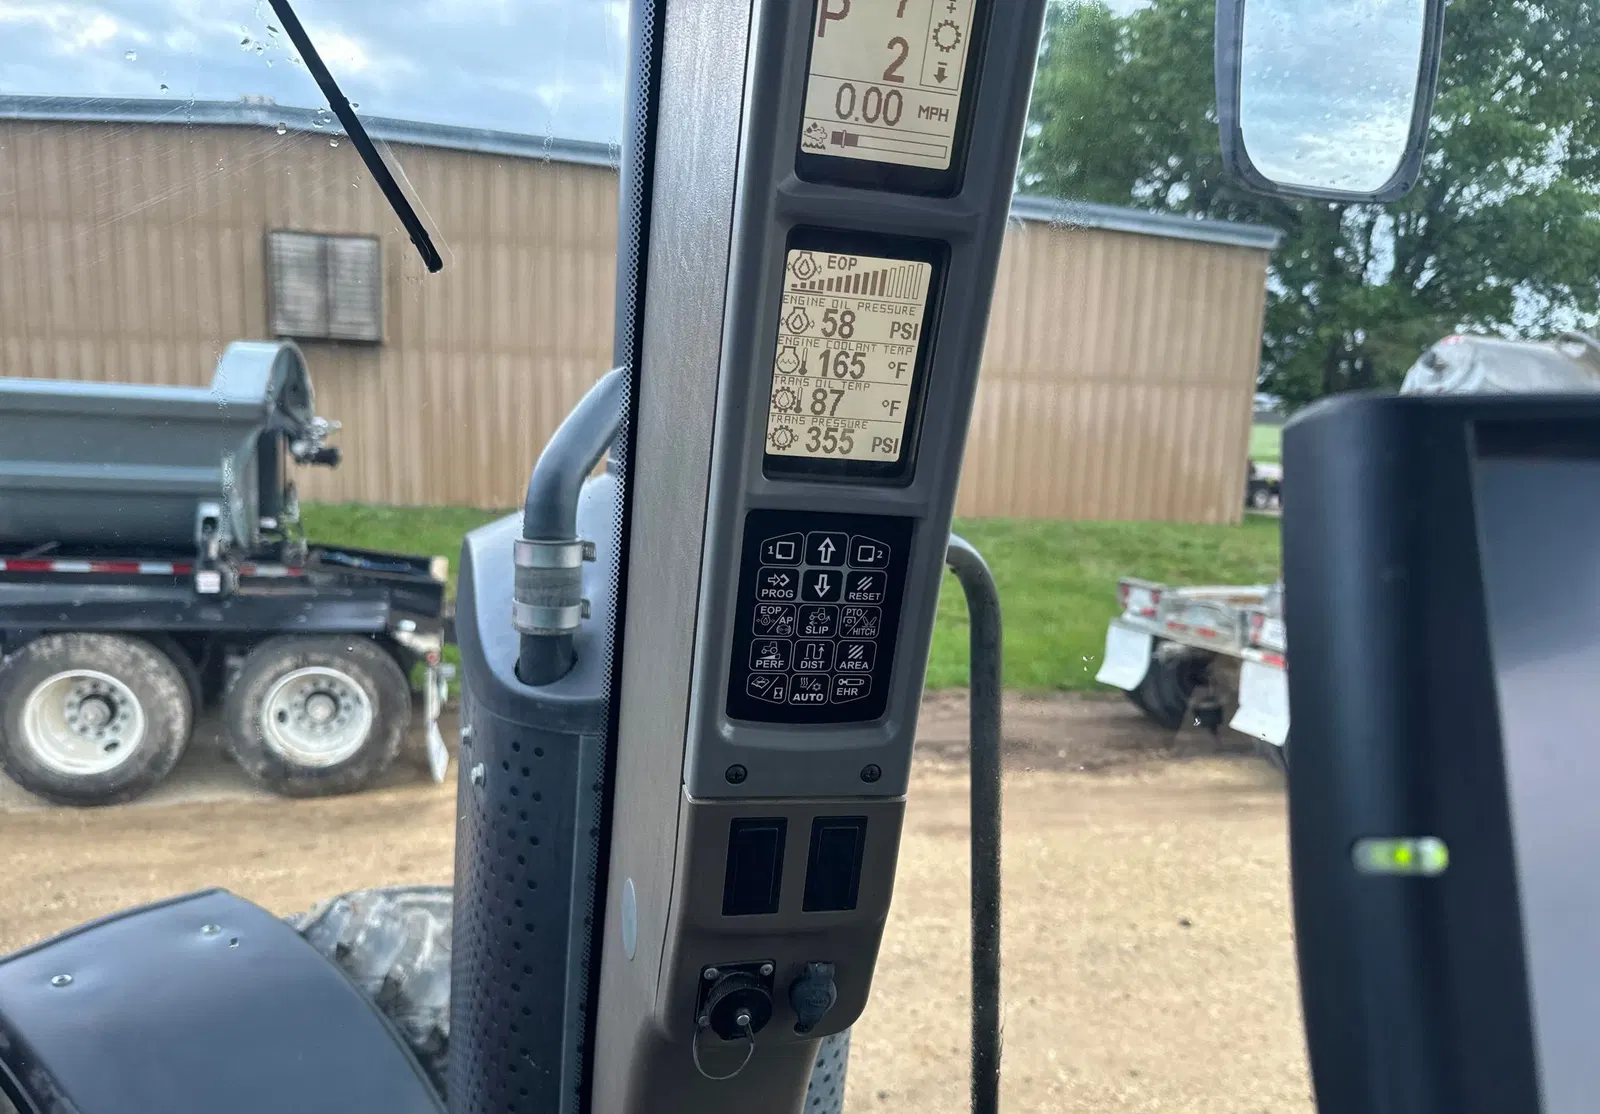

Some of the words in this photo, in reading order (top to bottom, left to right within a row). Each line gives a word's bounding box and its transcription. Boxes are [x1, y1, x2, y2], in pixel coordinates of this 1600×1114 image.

[882, 36, 909, 83] 2
[835, 83, 903, 126] 0.00
[918, 105, 950, 122] MPH
[827, 255, 858, 271] EOP
[782, 294, 825, 308] ENGINE
[831, 299, 850, 310] OIL
[857, 302, 916, 316] PRESSURE
[821, 308, 856, 339] 58
[889, 321, 919, 341] PSI
[777, 335, 820, 348] ENGINE
[826, 340, 877, 353] COOLANT
[884, 345, 913, 355] TEMP
[819, 349, 867, 380] 165
[888, 361, 908, 379] °F
[774, 375, 810, 387] TRANS
[815, 380, 834, 388] OIL
[842, 381, 871, 391] TEMP
[810, 388, 845, 416] 87
[882, 400, 901, 417] °F
[771, 414, 806, 425] TRANS
[811, 417, 869, 430] PRESSURE
[805, 426, 855, 455] 355
[871, 436, 900, 455] PSI
[767, 545, 775, 555] 1
[876, 550, 883, 559] 2
[761, 588, 794, 598] PROG
[849, 592, 881, 601] RESET
[760, 605, 782, 615] EOP
[846, 608, 863, 617] PTO
[778, 616, 793, 625] AP
[805, 626, 829, 635] SLIP
[852, 627, 876, 636] HITCH
[755, 660, 784, 669] PERF
[800, 660, 825, 669] DIST
[839, 661, 869, 670] AREA
[836, 687, 859, 696] EHR
[792, 693, 824, 702] AUTO
